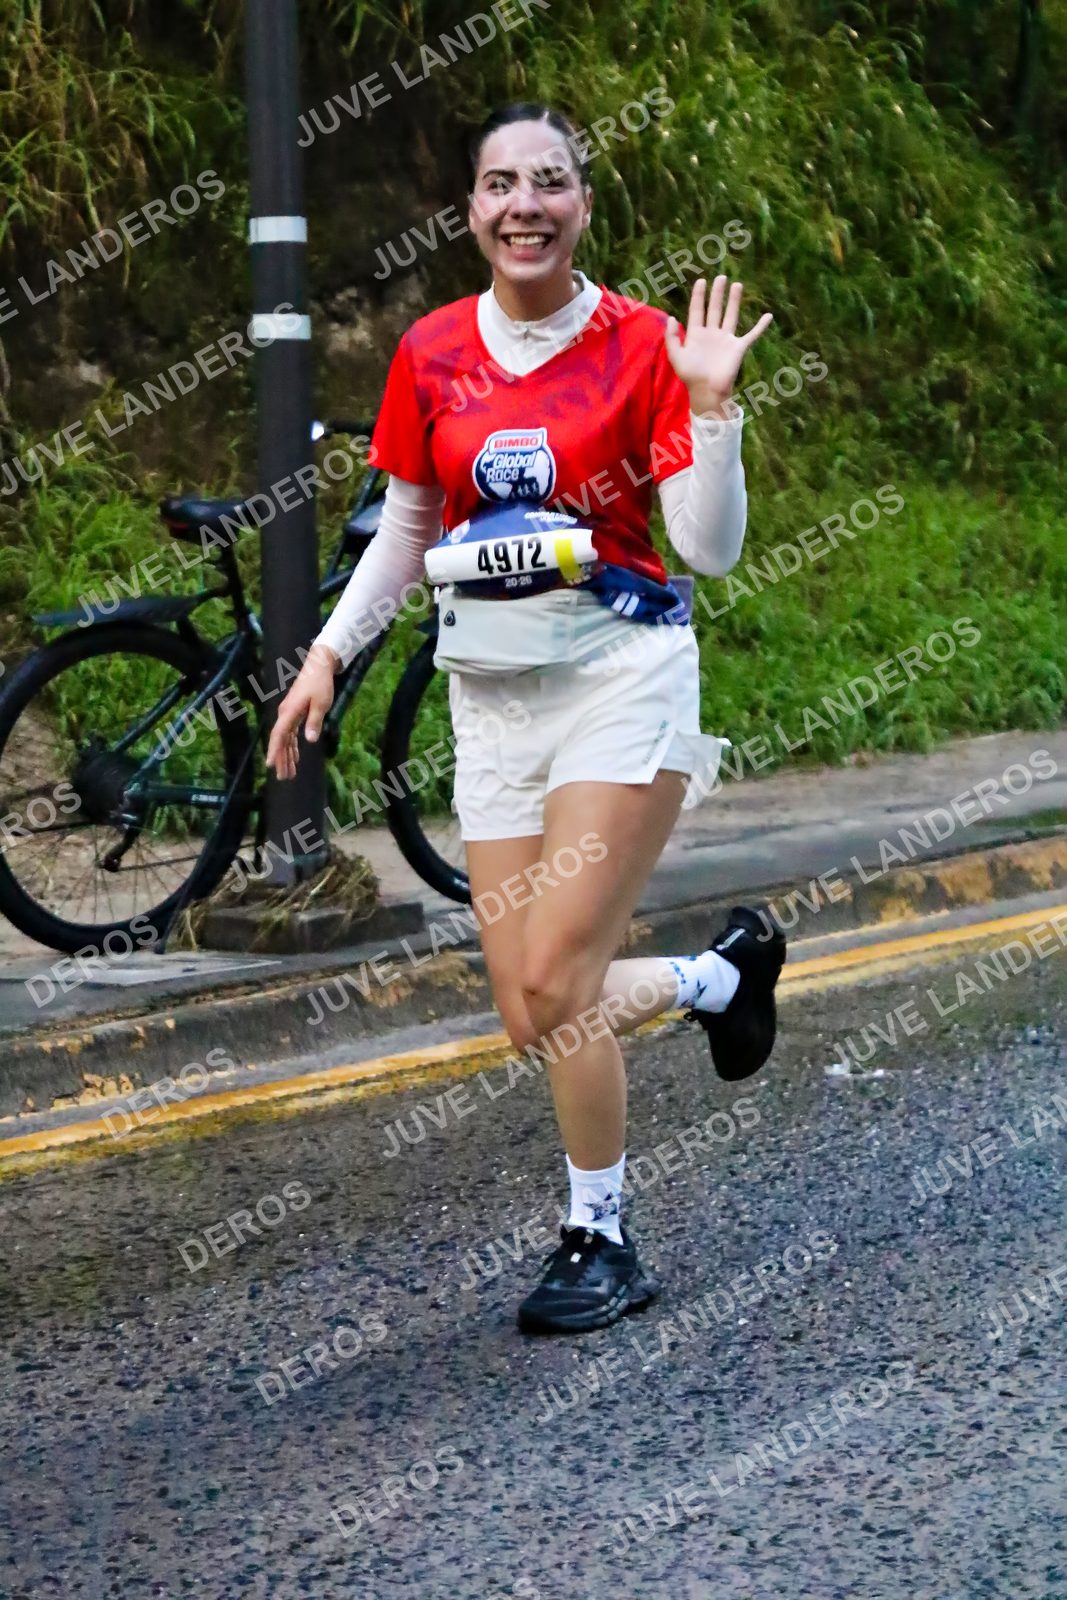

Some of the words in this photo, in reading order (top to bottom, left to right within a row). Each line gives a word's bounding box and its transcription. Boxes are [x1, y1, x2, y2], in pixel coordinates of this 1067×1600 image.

[494, 437, 539, 449] BIMBO
[493, 452, 537, 469] Global
[486, 467, 519, 483] Race
[477, 536, 547, 575] 4972
